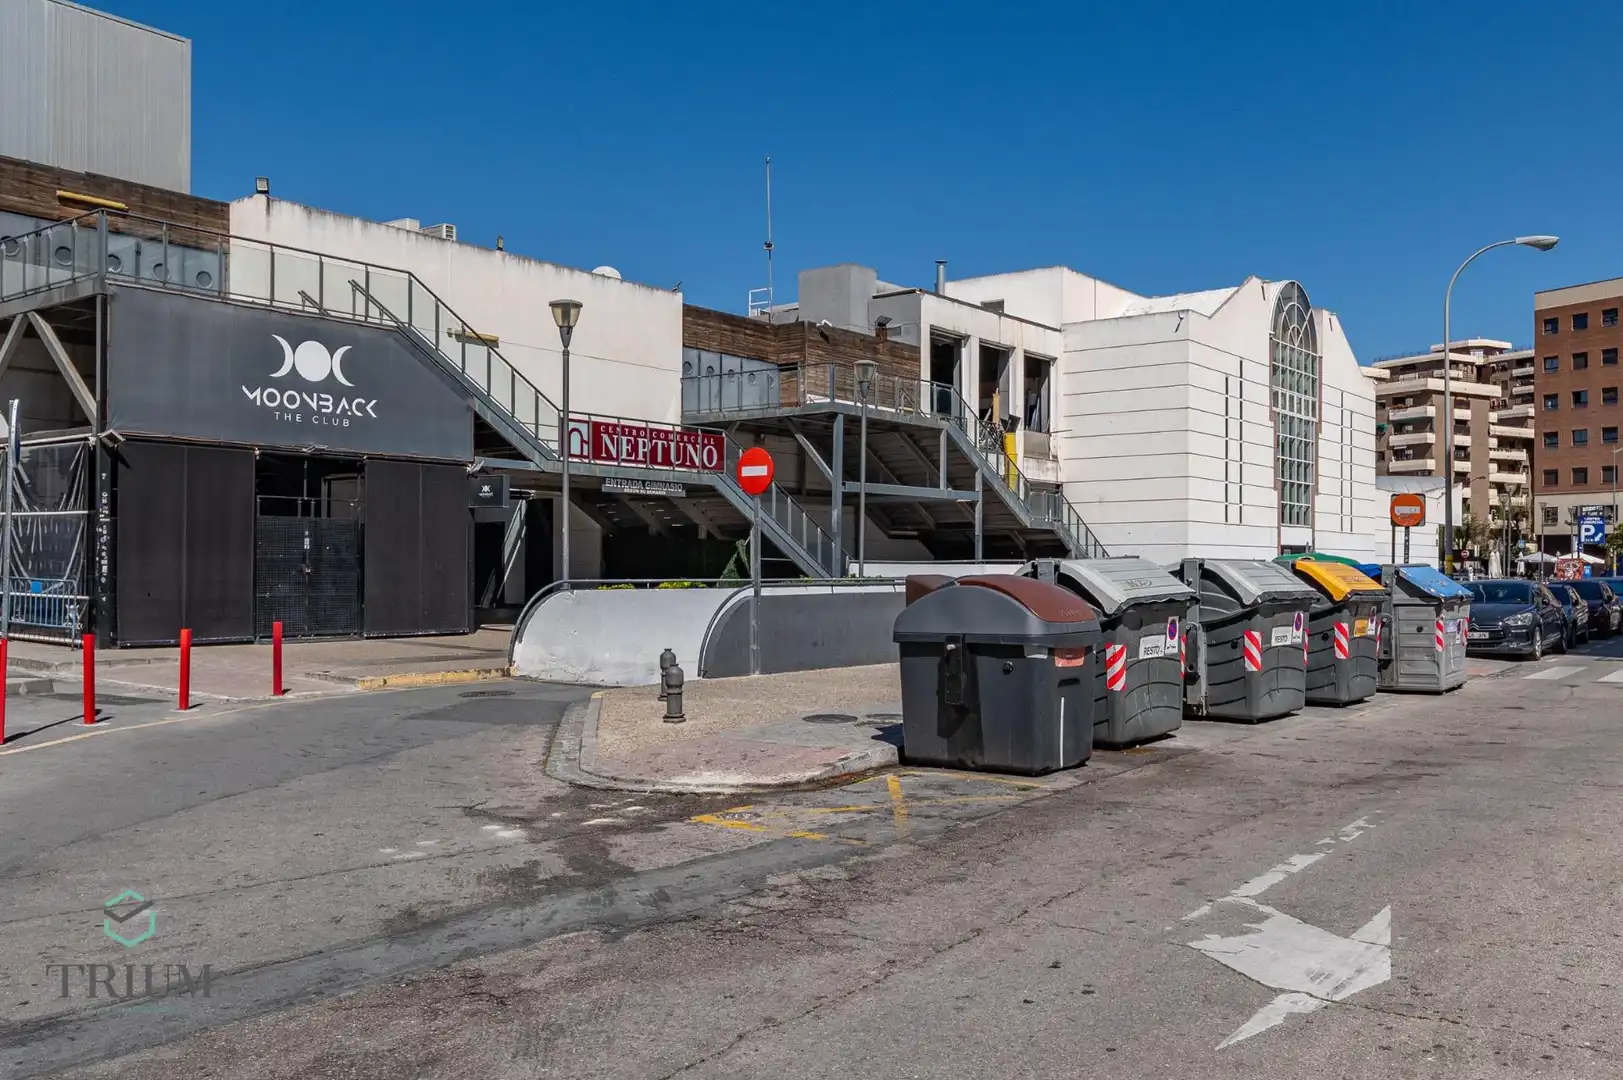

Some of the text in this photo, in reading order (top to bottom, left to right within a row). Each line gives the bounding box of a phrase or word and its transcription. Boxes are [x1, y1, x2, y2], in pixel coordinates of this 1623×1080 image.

[242, 385, 377, 418] MOONBACK
[274, 412, 350, 427] THE CLUB
[601, 425, 645, 437] CENTRO
[601, 433, 718, 468] NEPTUNO
[605, 477, 683, 492] ENTRADA GIMNASIO
[1580, 524, 1596, 542] P
[1143, 645, 1160, 656] RESTO
